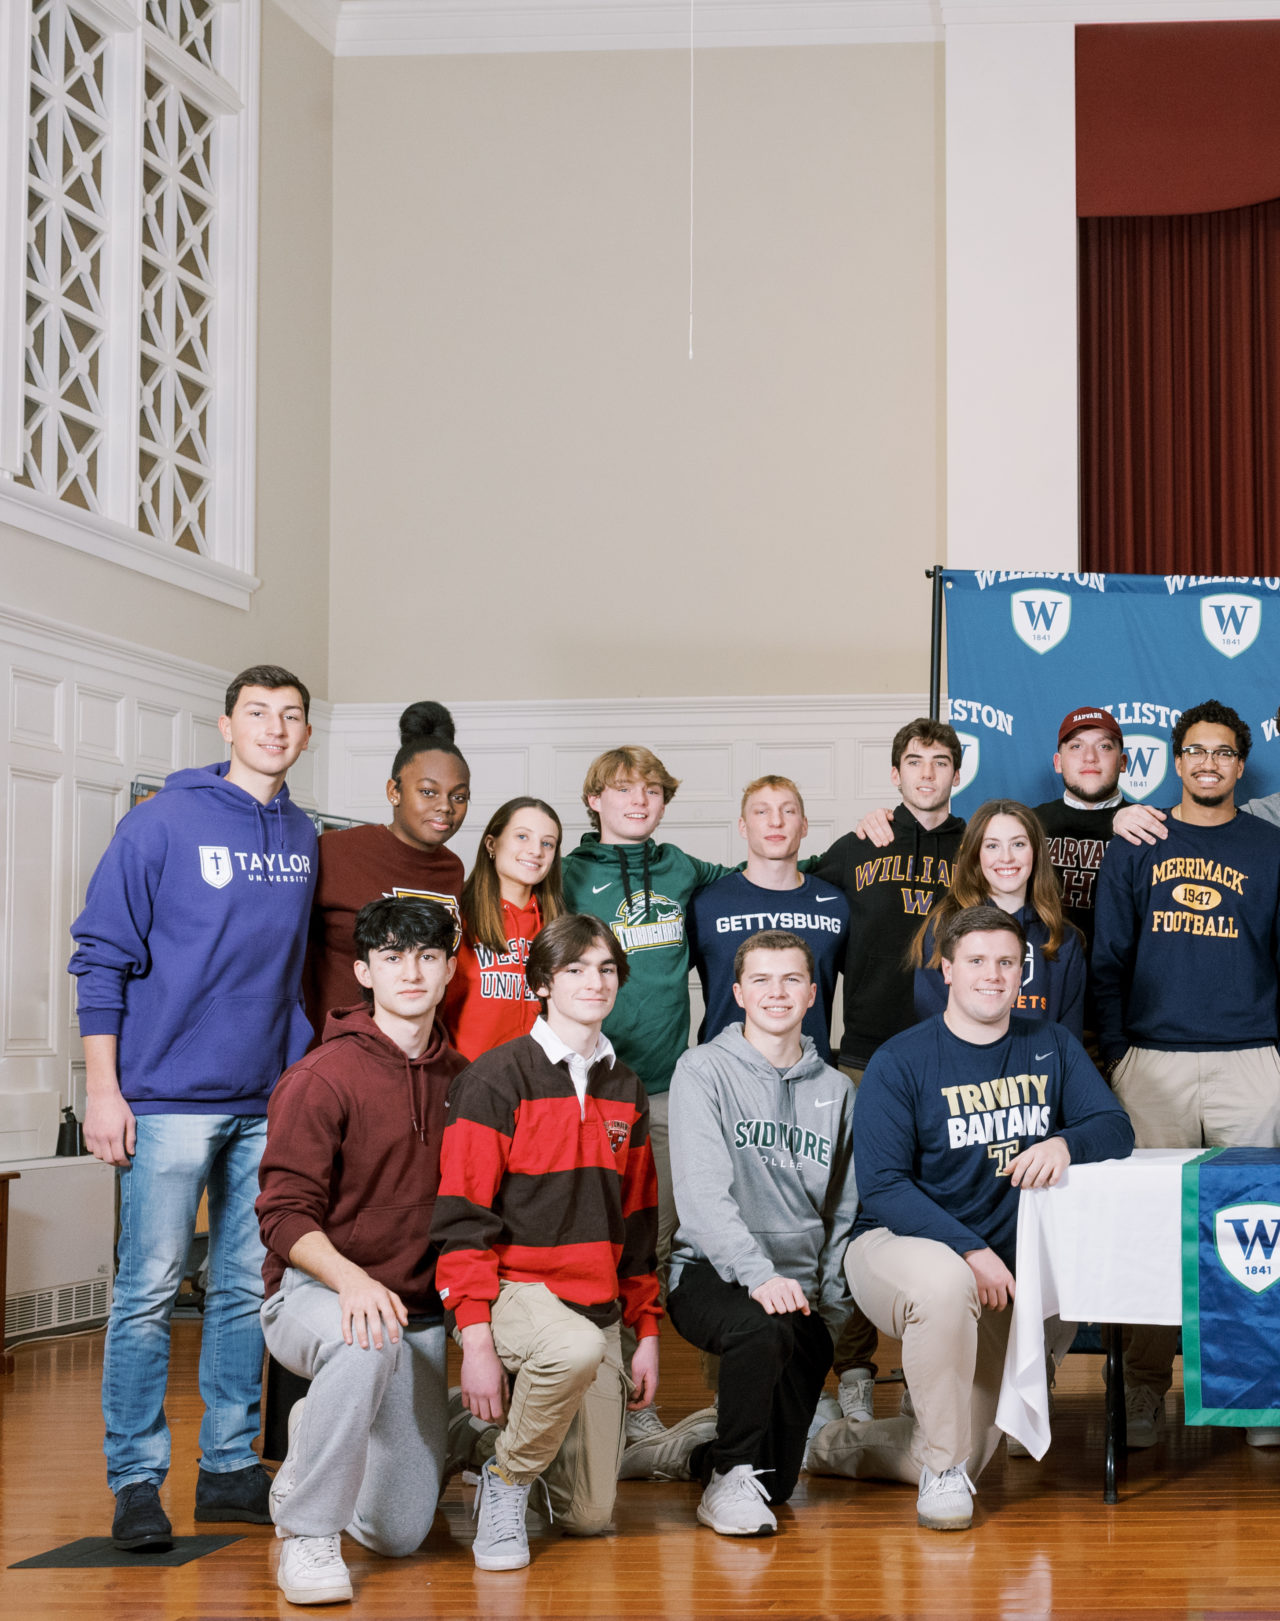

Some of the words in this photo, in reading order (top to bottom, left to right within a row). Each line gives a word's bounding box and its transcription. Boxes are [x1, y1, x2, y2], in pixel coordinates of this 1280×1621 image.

[1019, 600, 1063, 631] W
[1208, 605, 1253, 635] W
[1222, 638, 1241, 646] 1841
[1130, 780, 1148, 788] 1841
[234, 851, 311, 874] TAYLOR
[1044, 836, 1111, 870] ARVA
[1061, 869, 1096, 909] H
[1152, 857, 1244, 896] MERRIMACK
[900, 888, 934, 916] W
[1183, 887, 1212, 906] 1947
[716, 912, 841, 934] GETTYSBURG
[1152, 911, 1239, 938] FOOTBALL
[480, 971, 540, 1002] UNIVE
[1011, 995, 1047, 1010] ETS
[941, 1074, 1049, 1117] TRINITY
[947, 1105, 1051, 1150] BANTAMS
[987, 1139, 1020, 1178] T
[1245, 1266, 1272, 1275] 1841
